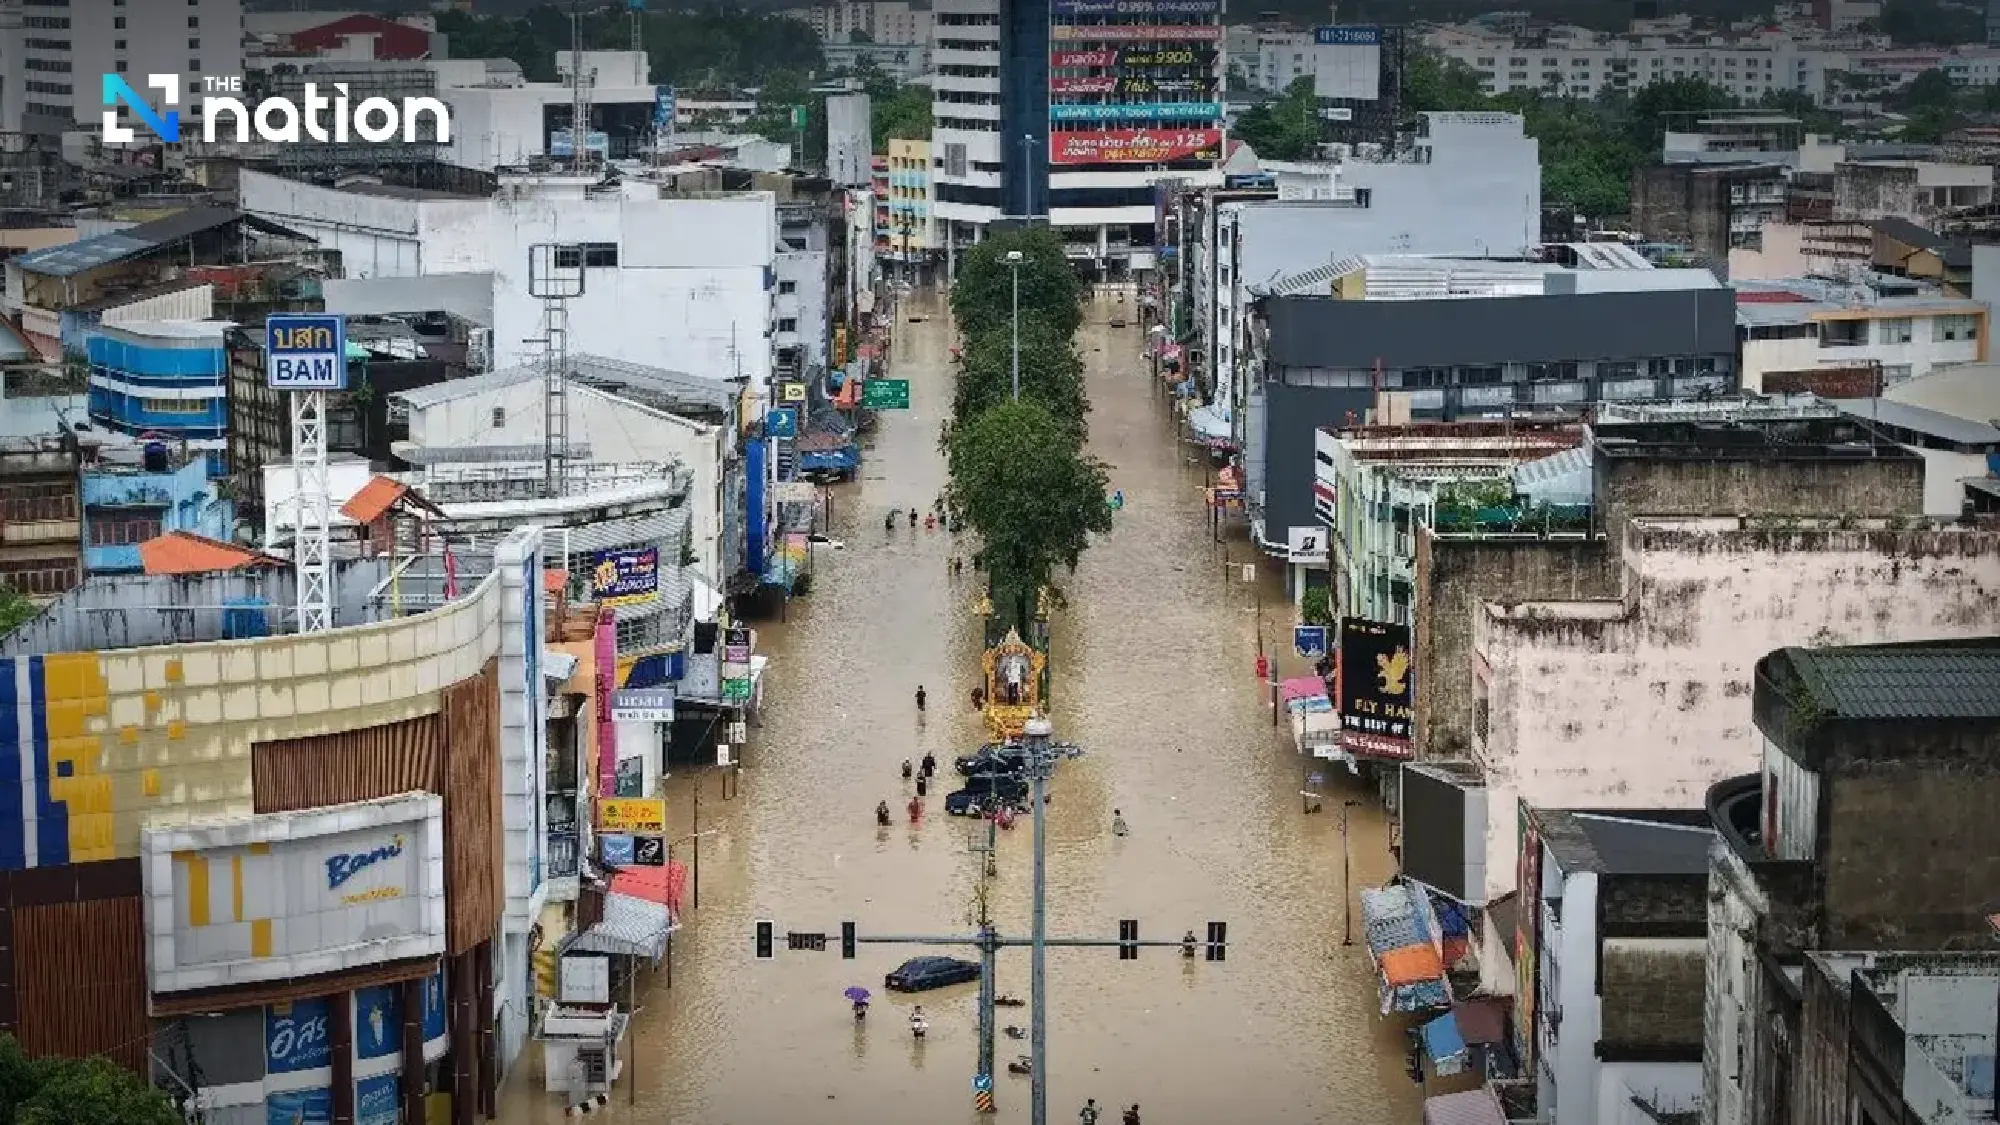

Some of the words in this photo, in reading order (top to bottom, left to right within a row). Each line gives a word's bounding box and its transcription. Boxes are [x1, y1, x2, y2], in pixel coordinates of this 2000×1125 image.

[273, 326, 333, 349] บสก
[276, 359, 333, 381] BAM
[1354, 698, 1378, 714] FLY
